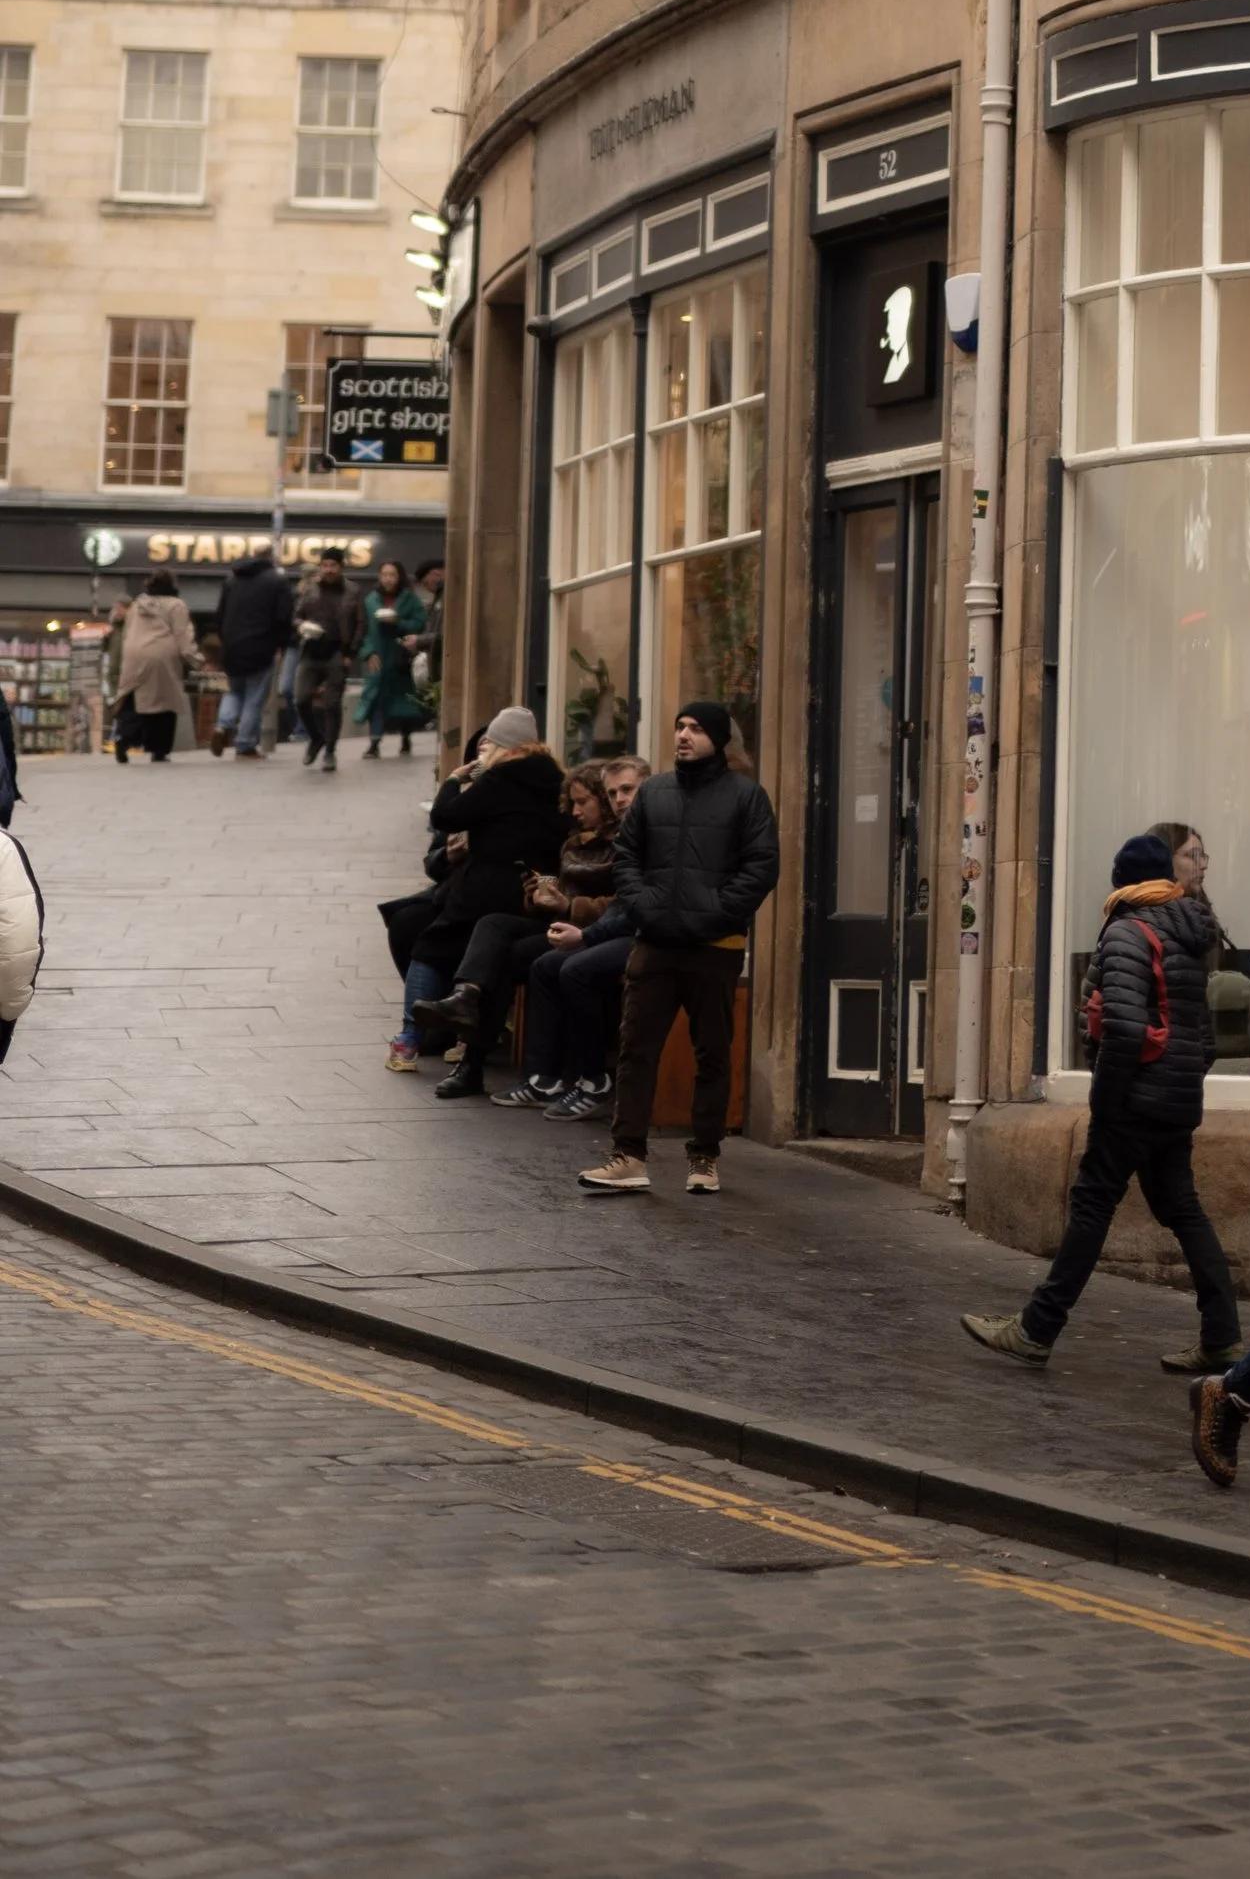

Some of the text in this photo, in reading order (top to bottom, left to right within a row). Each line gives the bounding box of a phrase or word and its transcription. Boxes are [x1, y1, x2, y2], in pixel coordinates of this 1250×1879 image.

[879, 149, 897, 180] 52
[339, 376, 449, 399] scottish
[331, 406, 386, 435] gift
